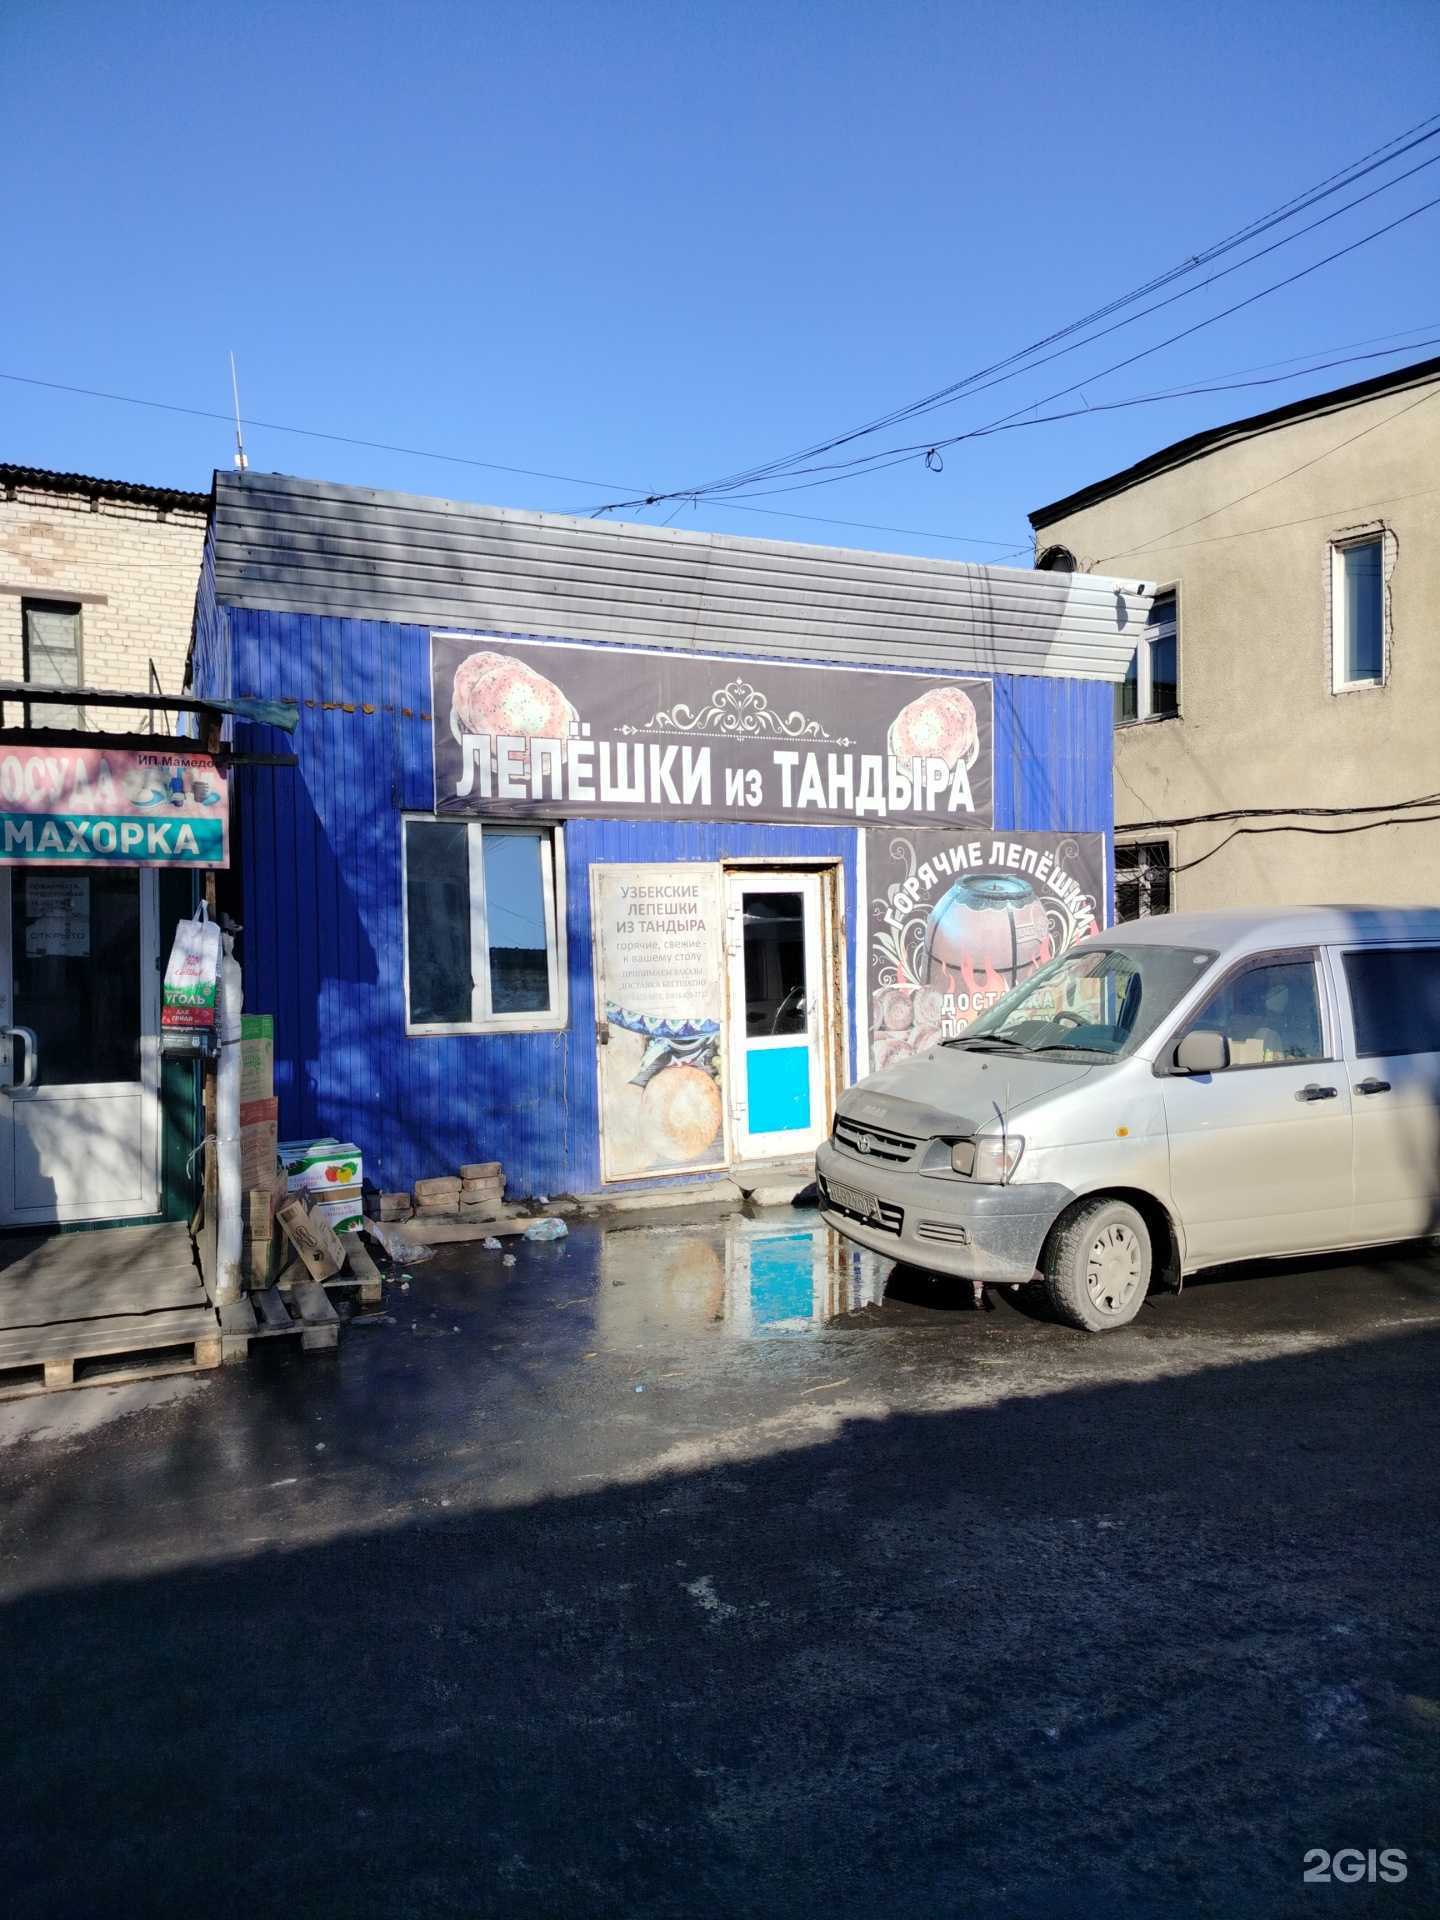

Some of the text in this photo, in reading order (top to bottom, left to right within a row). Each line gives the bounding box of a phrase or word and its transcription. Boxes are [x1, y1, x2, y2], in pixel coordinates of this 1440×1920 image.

[162, 756, 215, 768] Мамедо
[456, 721, 712, 805] ЛЕПЁШКИ
[773, 750, 976, 817] ТАНДЫРА
[4, 820, 200, 855] МАХОРКА
[620, 885, 699, 899] УЗБЕКСКИЕ
[884, 841, 1096, 930] ГОРЯЧИЕ ЛЕПЁШКИ
[628, 903, 697, 916] ЛЕПЕШКИ
[616, 919, 706, 934] ИЗ ТАНДЫРА
[675, 952, 703, 961] столу
[166, 994, 206, 1006] УГОЛЬ
